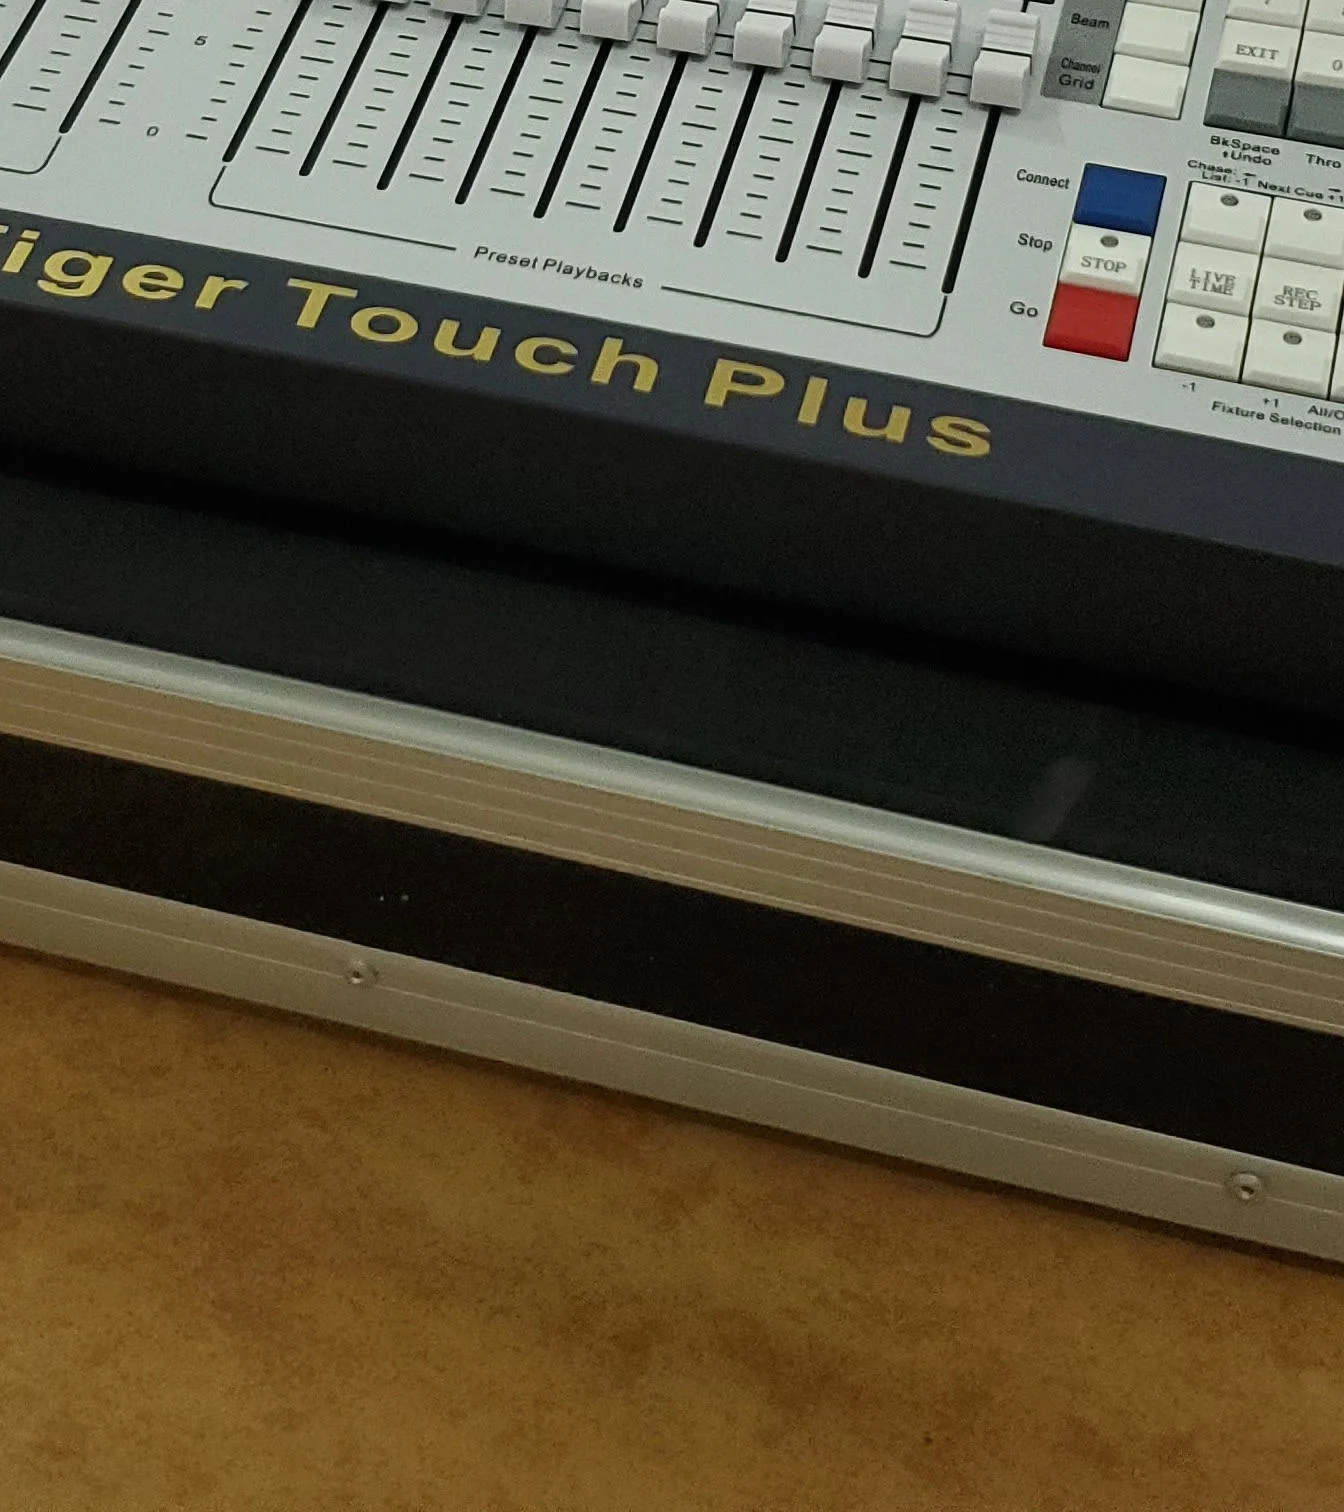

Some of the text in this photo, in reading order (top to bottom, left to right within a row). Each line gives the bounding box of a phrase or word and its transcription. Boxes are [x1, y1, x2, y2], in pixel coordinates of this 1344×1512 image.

[1071, 13, 1109, 29] Beam
[195, 36, 206, 45] 5
[1060, 57, 1101, 75] Channel
[1235, 44, 1279, 61] EXIT
[1333, 60, 1342, 71] 0
[1059, 75, 1094, 90] Grid
[147, 126, 159, 136] 0
[1210, 136, 1280, 156] BkSpace
[1306, 153, 1342, 169] Thro
[1016, 169, 1069, 190] Connect
[1258, 180, 1291, 194] Next
[1017, 234, 1053, 251] Stop
[474, 246, 643, 288] Preset Playbacks
[1081, 256, 1127, 273] STOP
[1189, 269, 1236, 287] LIVE
[1189, 277, 1233, 296] TIME
[1283, 285, 1318, 300] REC
[1010, 301, 1038, 319] Go
[1274, 295, 1321, 312] STEP
[286, 278, 659, 393] Touch
[703, 358, 993, 458] Plus
[1262, 397, 1280, 407] +1
[1212, 401, 1264, 419] Fixture
[1269, 411, 1341, 436] Selection
